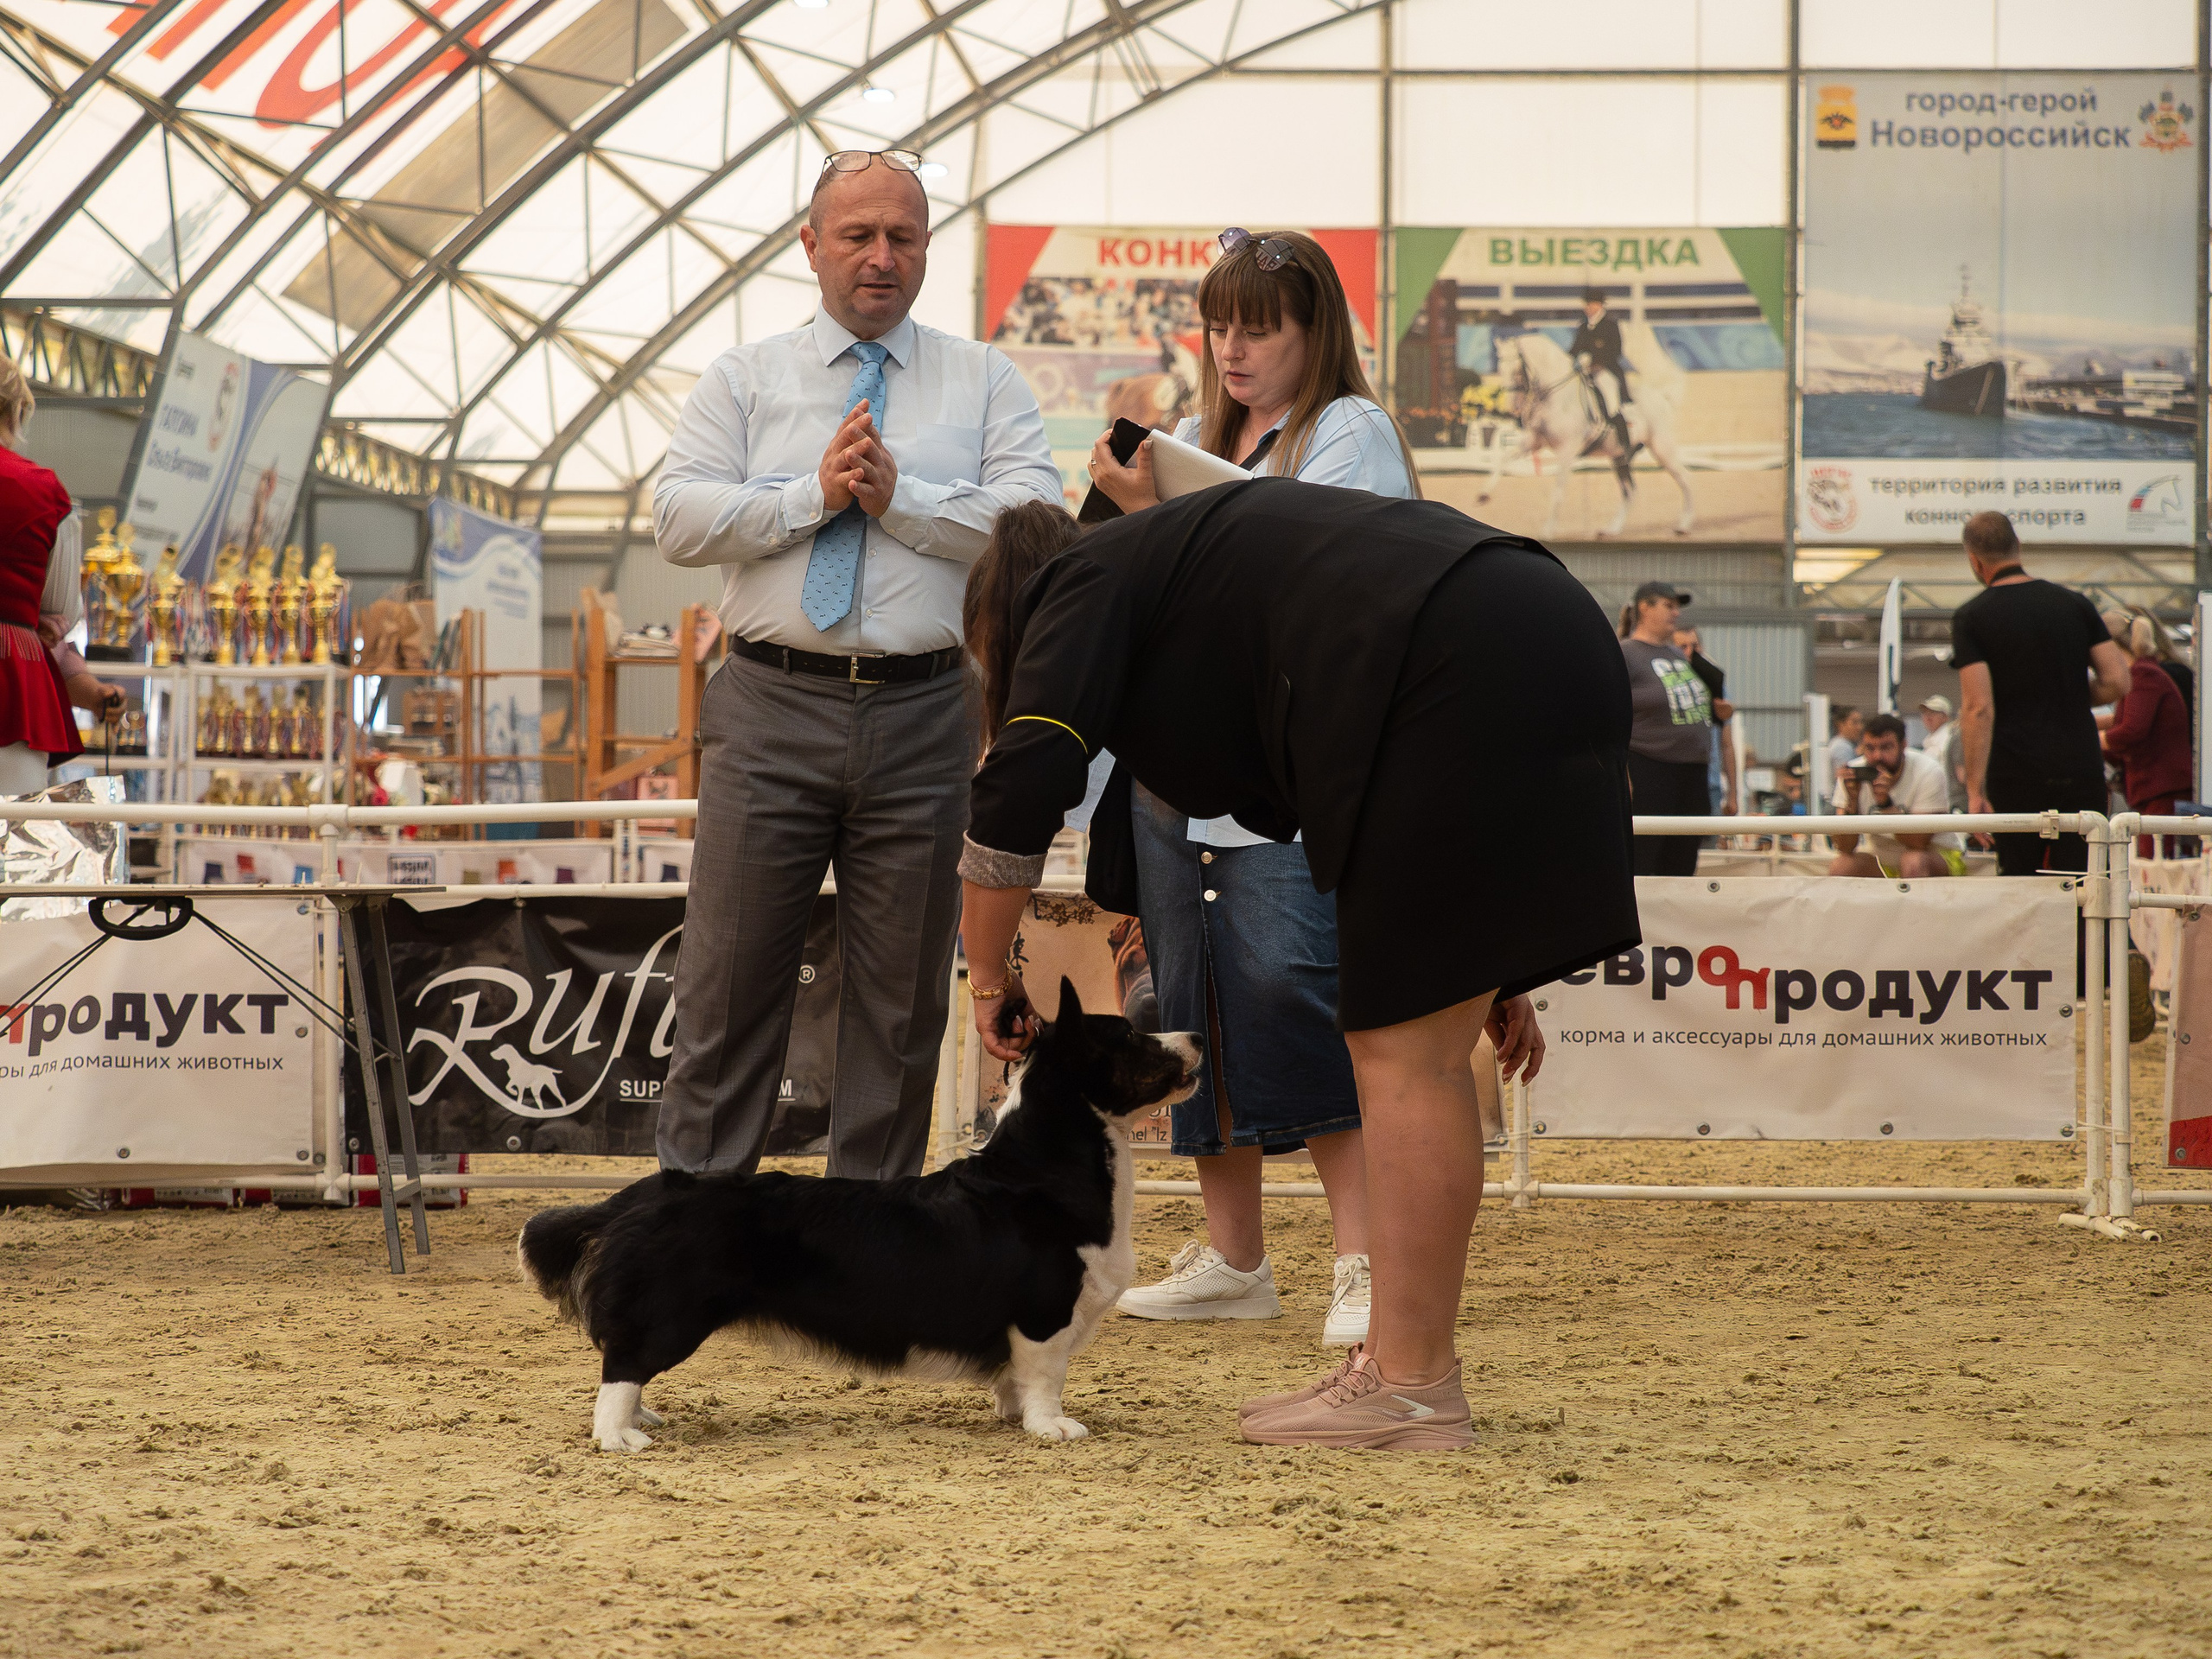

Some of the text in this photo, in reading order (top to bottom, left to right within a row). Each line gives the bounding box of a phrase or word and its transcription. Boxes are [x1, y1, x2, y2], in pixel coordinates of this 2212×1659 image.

[1905, 86, 2097, 117] город-герой
[1870, 118, 2131, 153] Новороссийск
[1099, 238, 1215, 267] КОНК
[1490, 238, 1700, 272] ВЫЕЗДКА
[1870, 479, 2121, 499] территория развития
[1560, 1030, 2048, 1048] корма и аксессуары для домашних животных
[29, 1060, 57, 1079] для
[60, 1055, 170, 1071] домашних
[176, 1057, 283, 1071] животных
